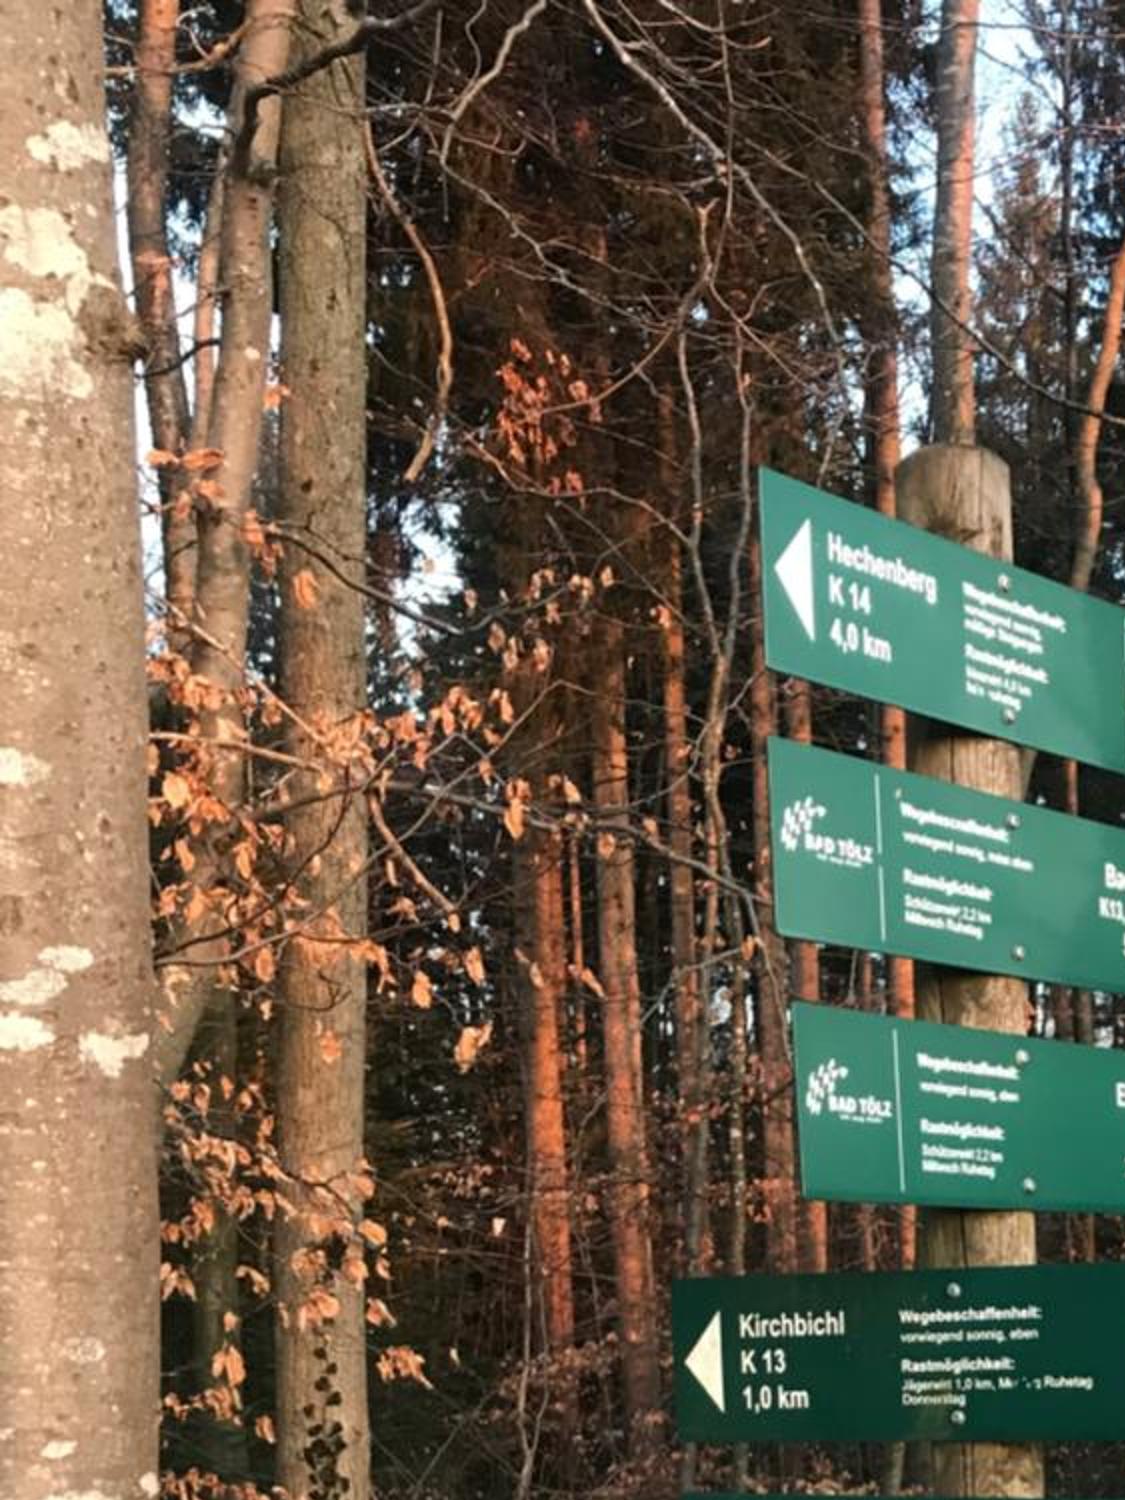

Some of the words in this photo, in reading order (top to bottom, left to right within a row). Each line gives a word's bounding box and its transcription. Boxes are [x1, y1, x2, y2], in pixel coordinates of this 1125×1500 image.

[828, 531, 937, 605] Hechenberg
[829, 574, 845, 607] K
[848, 581, 871, 614] 14
[830, 618, 859, 654] 4,0
[863, 626, 892, 662] km
[805, 832, 835, 853] BAD
[838, 838, 874, 865] TÖLZ
[828, 1095, 857, 1112] BAD
[859, 1095, 892, 1118] TÖLZ
[738, 1310, 845, 1338] Kirchbichl
[899, 1306, 1043, 1327] Wegebeschaffenheit:
[900, 1329, 964, 1345] vorwiegend
[1009, 1328, 1040, 1340] eben
[740, 1349, 757, 1375] K
[762, 1348, 787, 1375] 13
[900, 1355, 1015, 1375] Rastmöglichkeit:
[955, 1377, 973, 1392] 1,0
[1043, 1374, 1094, 1391] Ruhetag
[742, 1384, 773, 1414] 1,0
[777, 1384, 810, 1409] km
